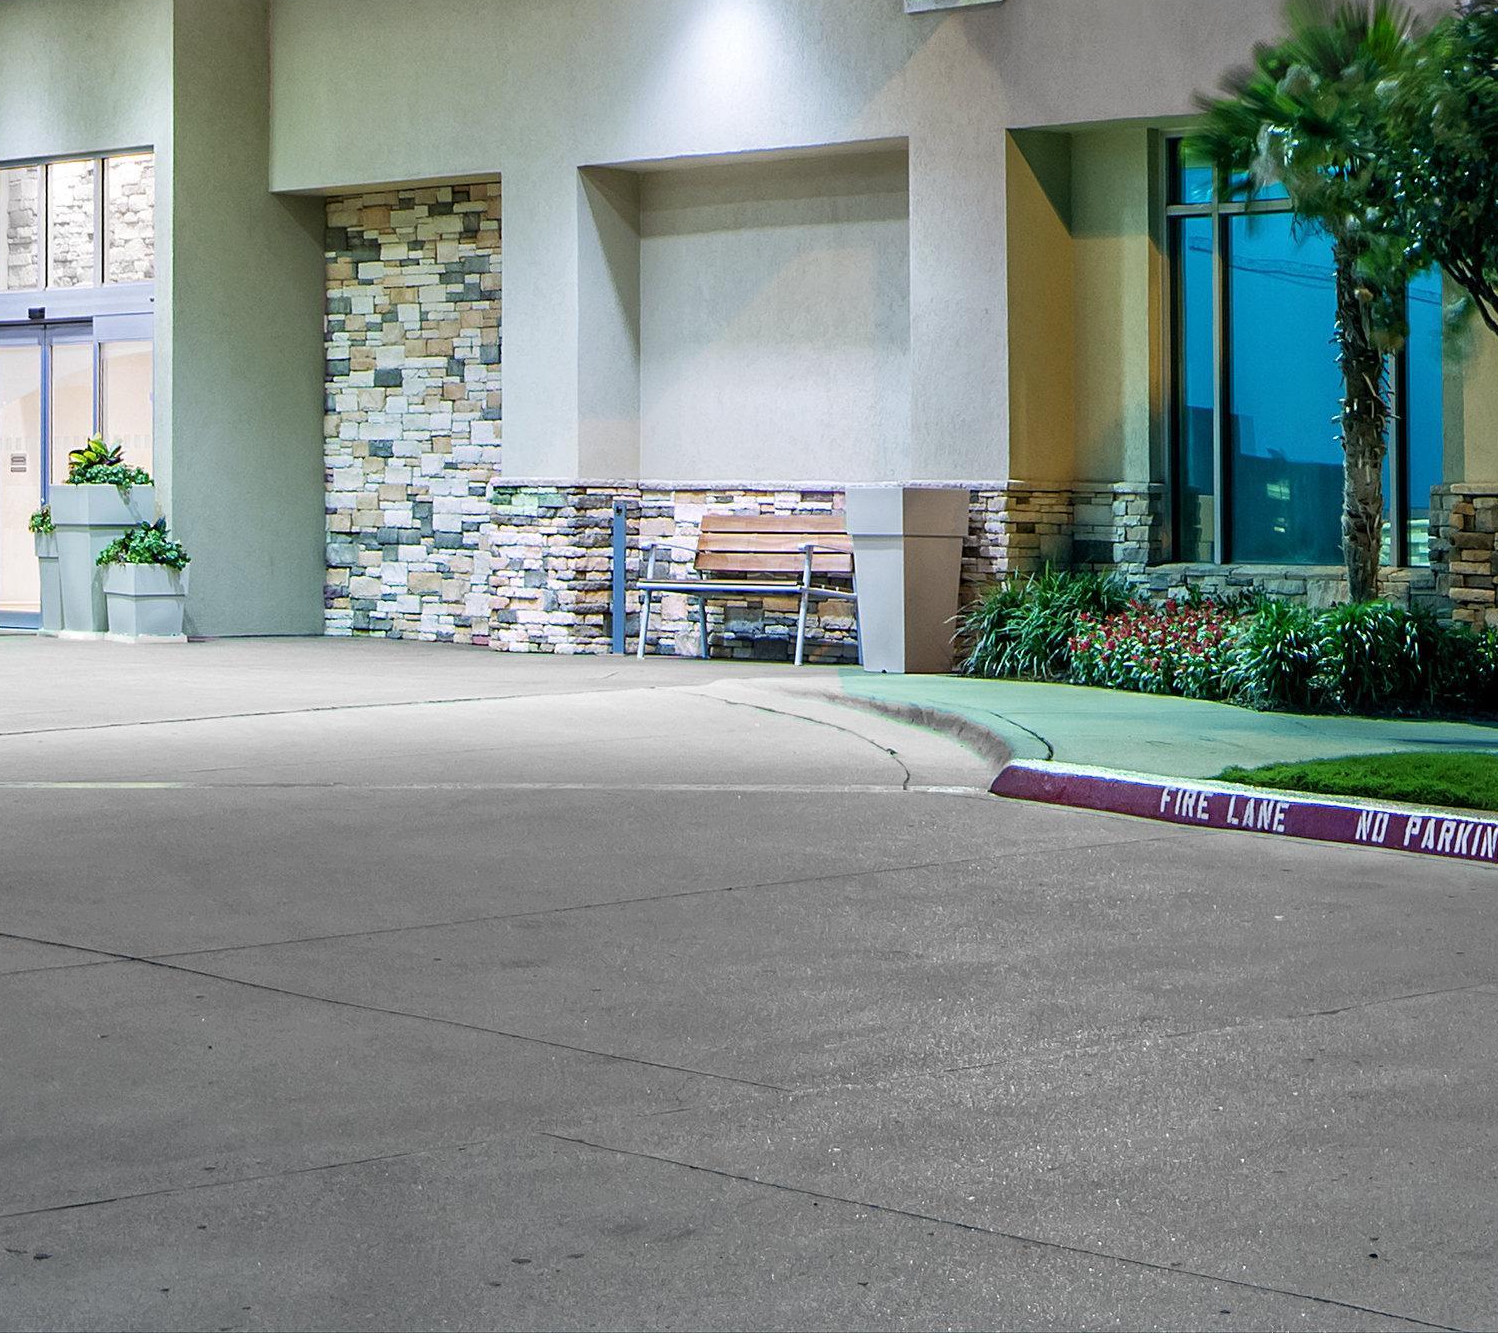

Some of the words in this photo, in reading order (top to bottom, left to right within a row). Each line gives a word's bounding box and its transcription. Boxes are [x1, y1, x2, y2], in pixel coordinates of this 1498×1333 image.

[1159, 786, 1214, 821] FIRE
[1226, 795, 1290, 833] LANE
[1354, 810, 1390, 844] NO
